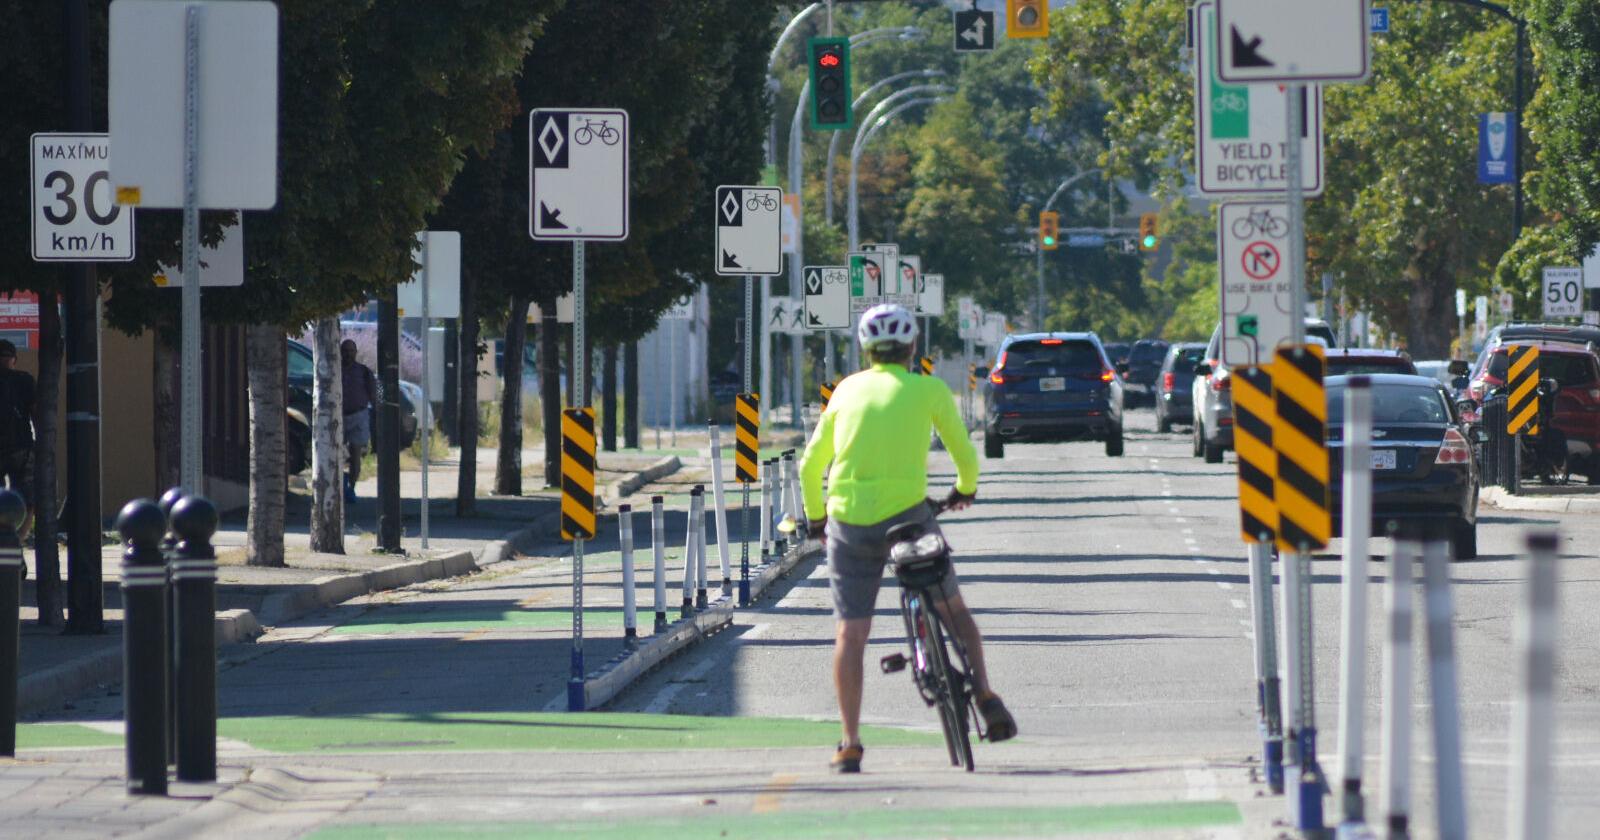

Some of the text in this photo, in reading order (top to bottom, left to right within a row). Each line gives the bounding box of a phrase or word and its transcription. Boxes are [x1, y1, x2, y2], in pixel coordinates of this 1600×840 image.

[42, 145, 108, 160] MAXIMU
[1219, 143, 1272, 160] YIELD
[1217, 163, 1289, 182] BICYCLE
[43, 170, 121, 226] 30
[52, 232, 115, 251] km/h
[1226, 283, 1246, 293] USE
[1249, 282, 1273, 293] BIKE
[1547, 281, 1579, 303] 50
